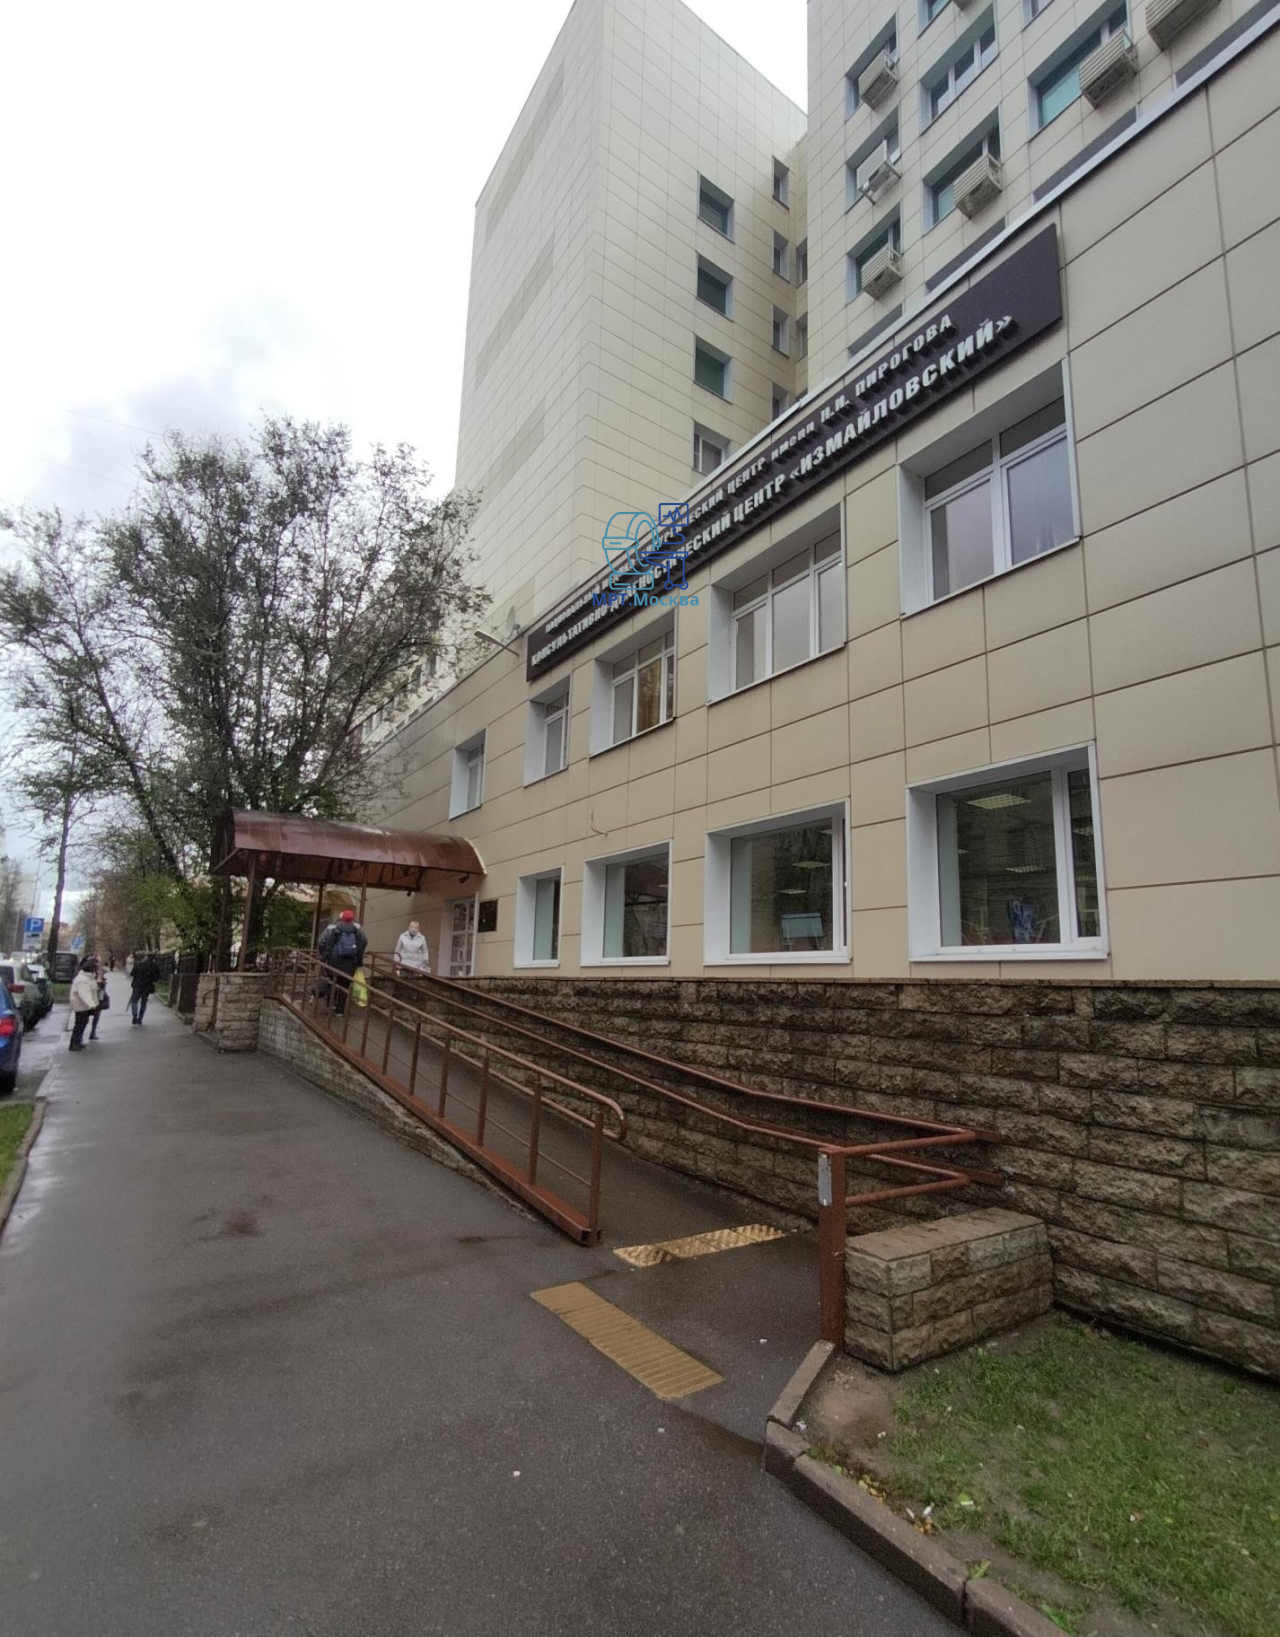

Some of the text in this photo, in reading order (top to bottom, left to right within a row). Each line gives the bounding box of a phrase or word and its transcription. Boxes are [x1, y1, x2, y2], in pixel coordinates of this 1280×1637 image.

[727, 457, 766, 494] ЦЕНТР
[855, 314, 953, 397] ПИРОГОВА
[733, 474, 786, 522] ЦЕНТР
[789, 315, 1013, 479] «ИЗМАЙЛОВСКИЙ»
[30, 919, 41, 931] P
